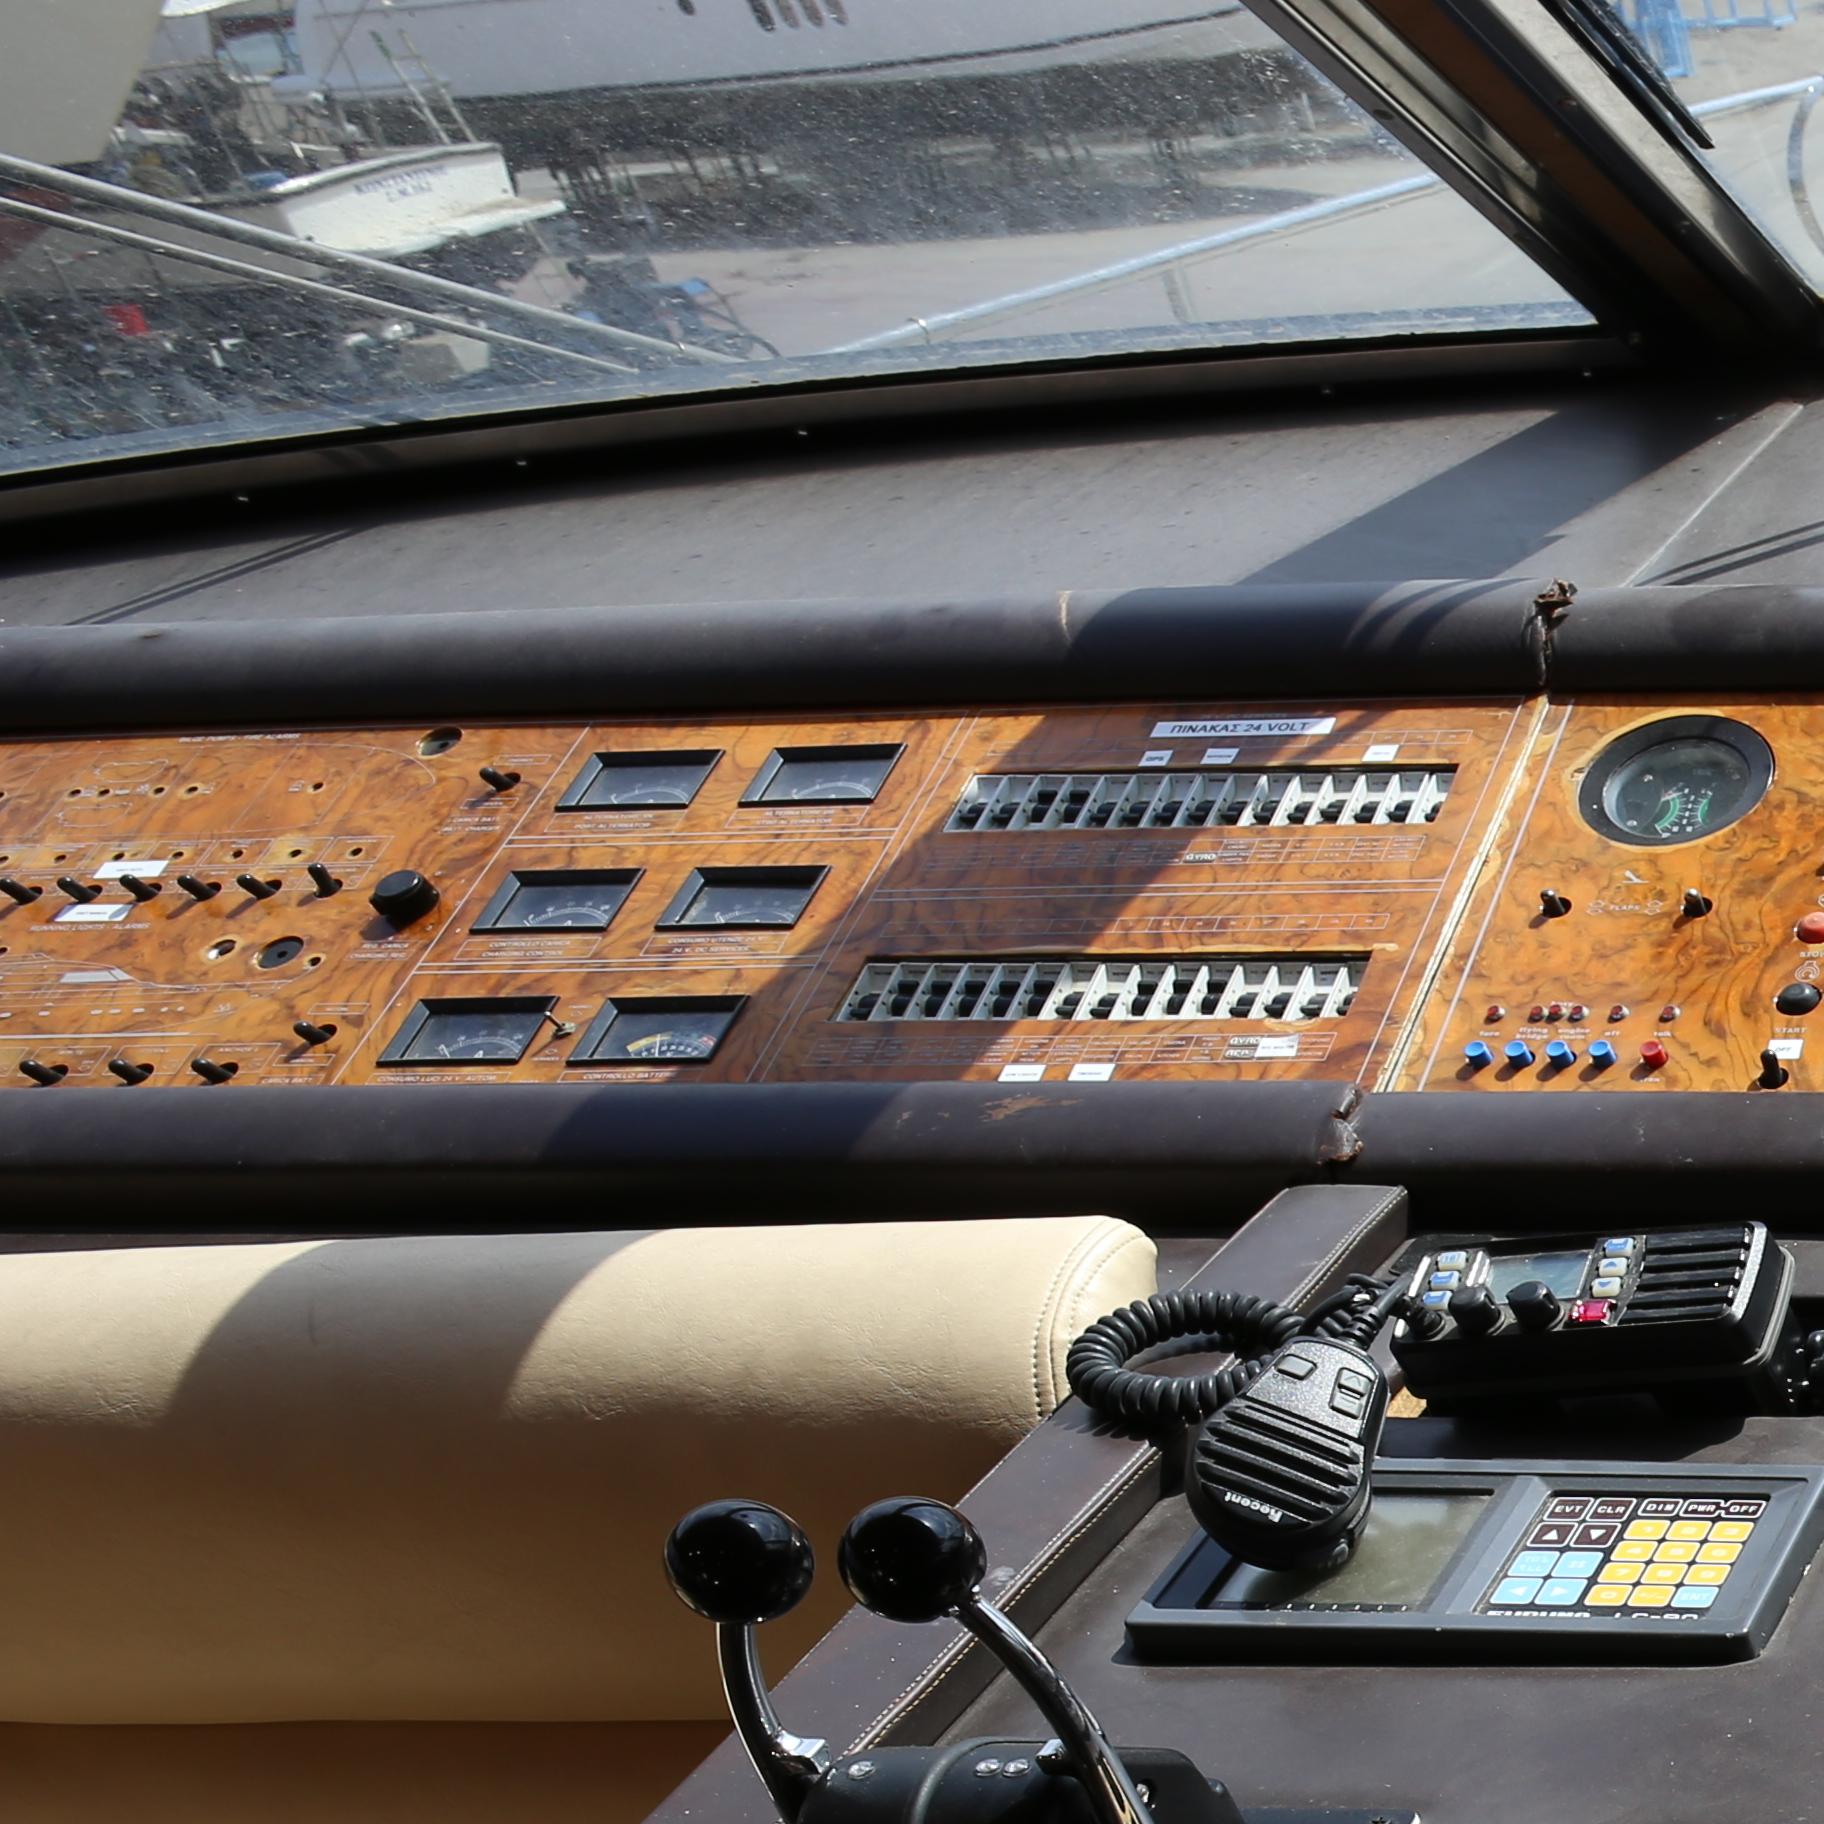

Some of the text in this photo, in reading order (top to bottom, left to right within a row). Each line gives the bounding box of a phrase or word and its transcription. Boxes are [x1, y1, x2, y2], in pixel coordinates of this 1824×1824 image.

[1170, 722, 1308, 734] ΠΙΝΑΚΑΣ 24 VOLT
[1185, 853, 1216, 862] GYRO
[1519, 1027, 1548, 1035] flying
[1516, 1032, 1549, 1040] bridge
[1554, 1505, 1583, 1513] EVT
[1596, 1505, 1625, 1513] CLR
[1646, 1503, 1674, 1511] DIM
[1687, 1504, 1716, 1512] PWR
[1729, 1505, 1759, 1513] OFF
